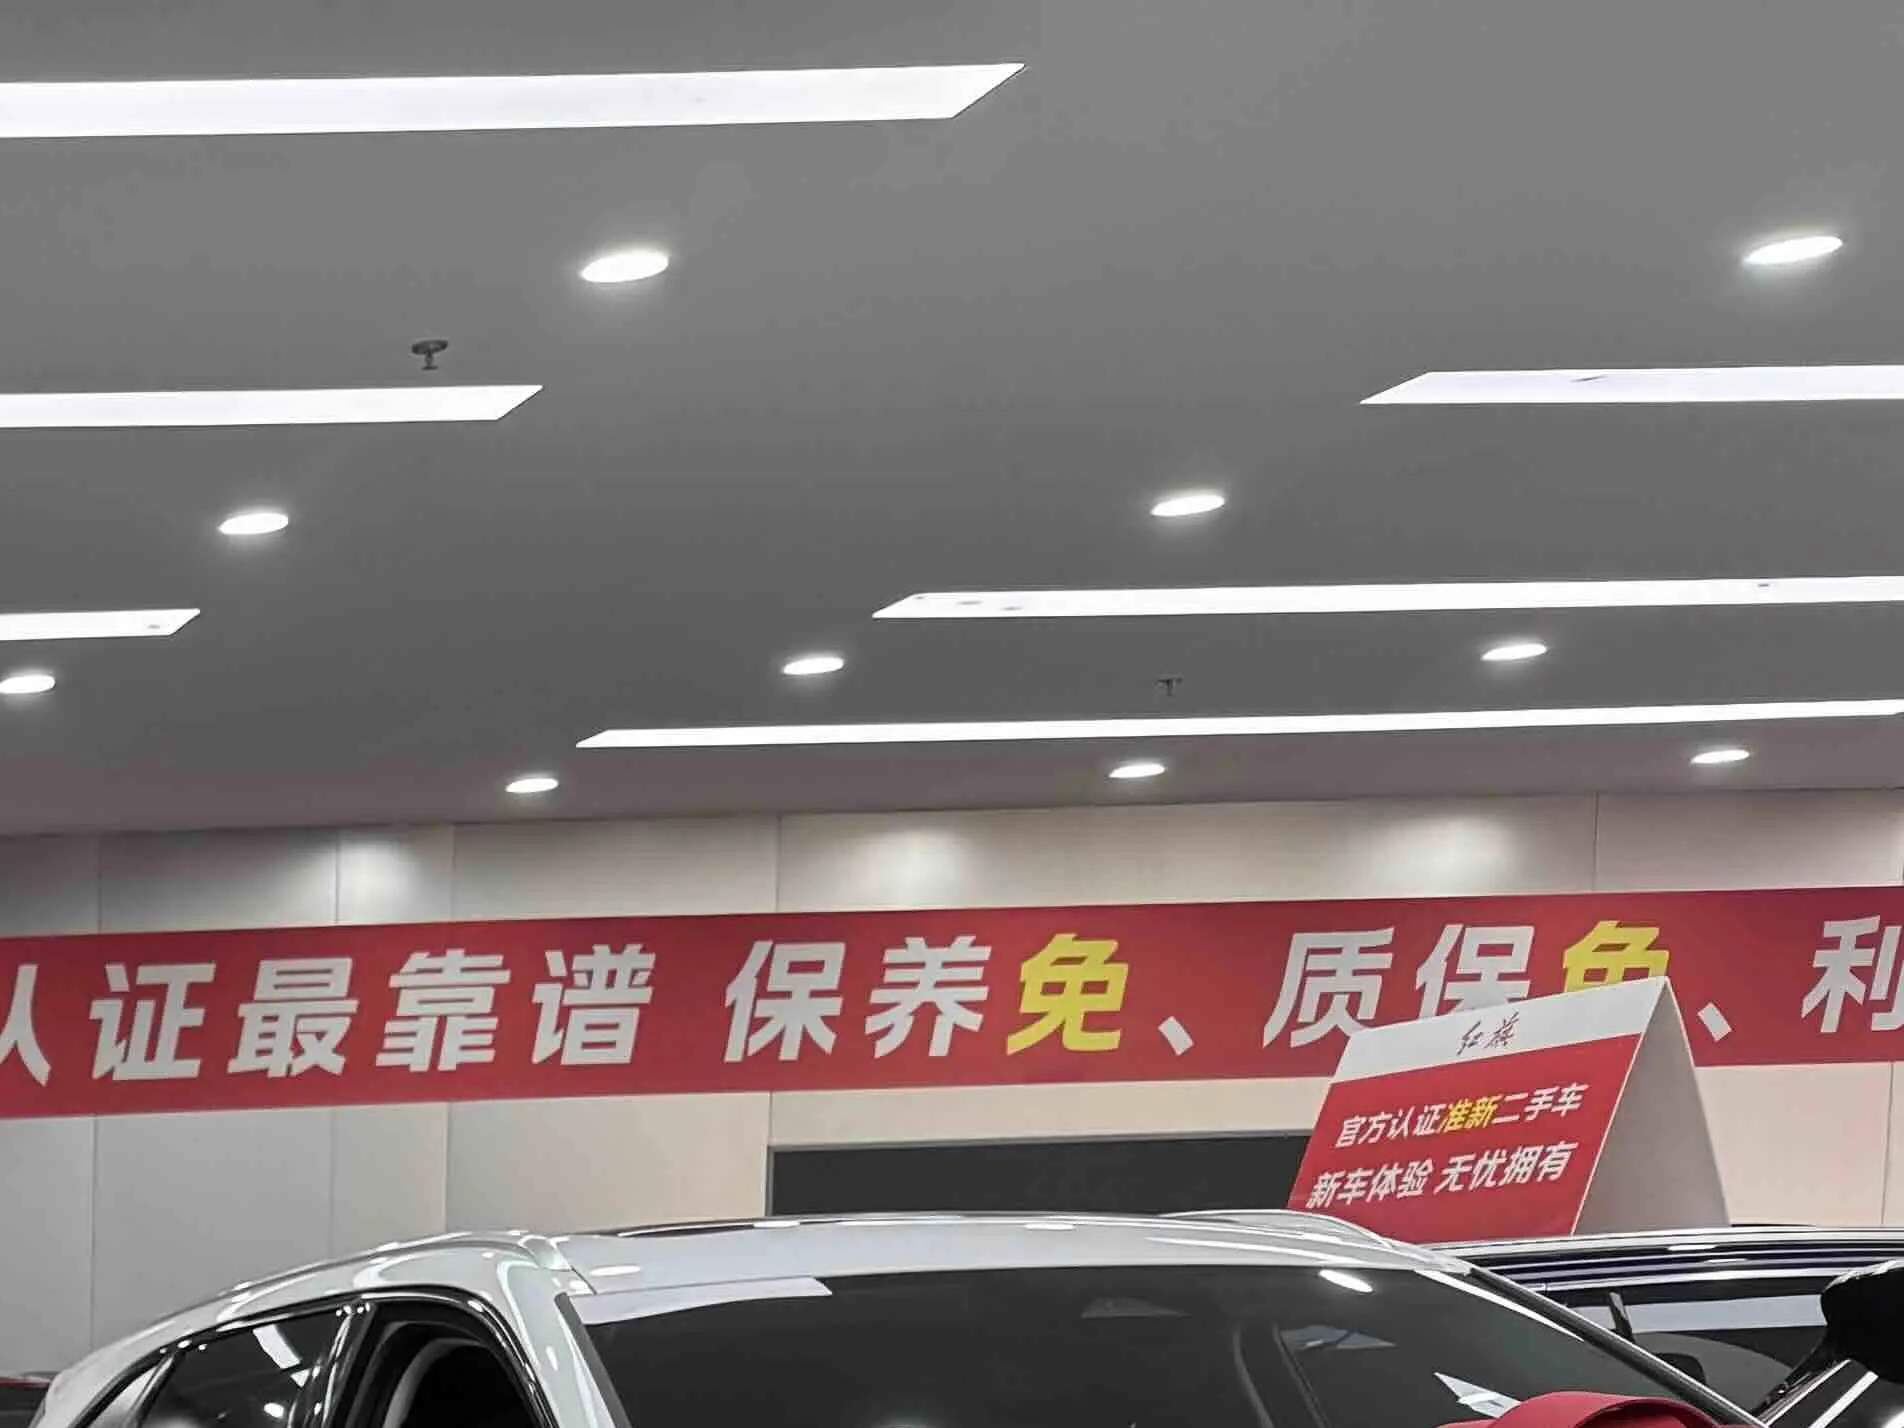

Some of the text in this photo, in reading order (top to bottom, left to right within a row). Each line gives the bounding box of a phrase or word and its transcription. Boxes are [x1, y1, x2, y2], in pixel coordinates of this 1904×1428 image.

[1335, 1083, 1590, 1149] 官方认证准新二手车
[1305, 1141, 1579, 1209] 新车体验 无忧拥有
